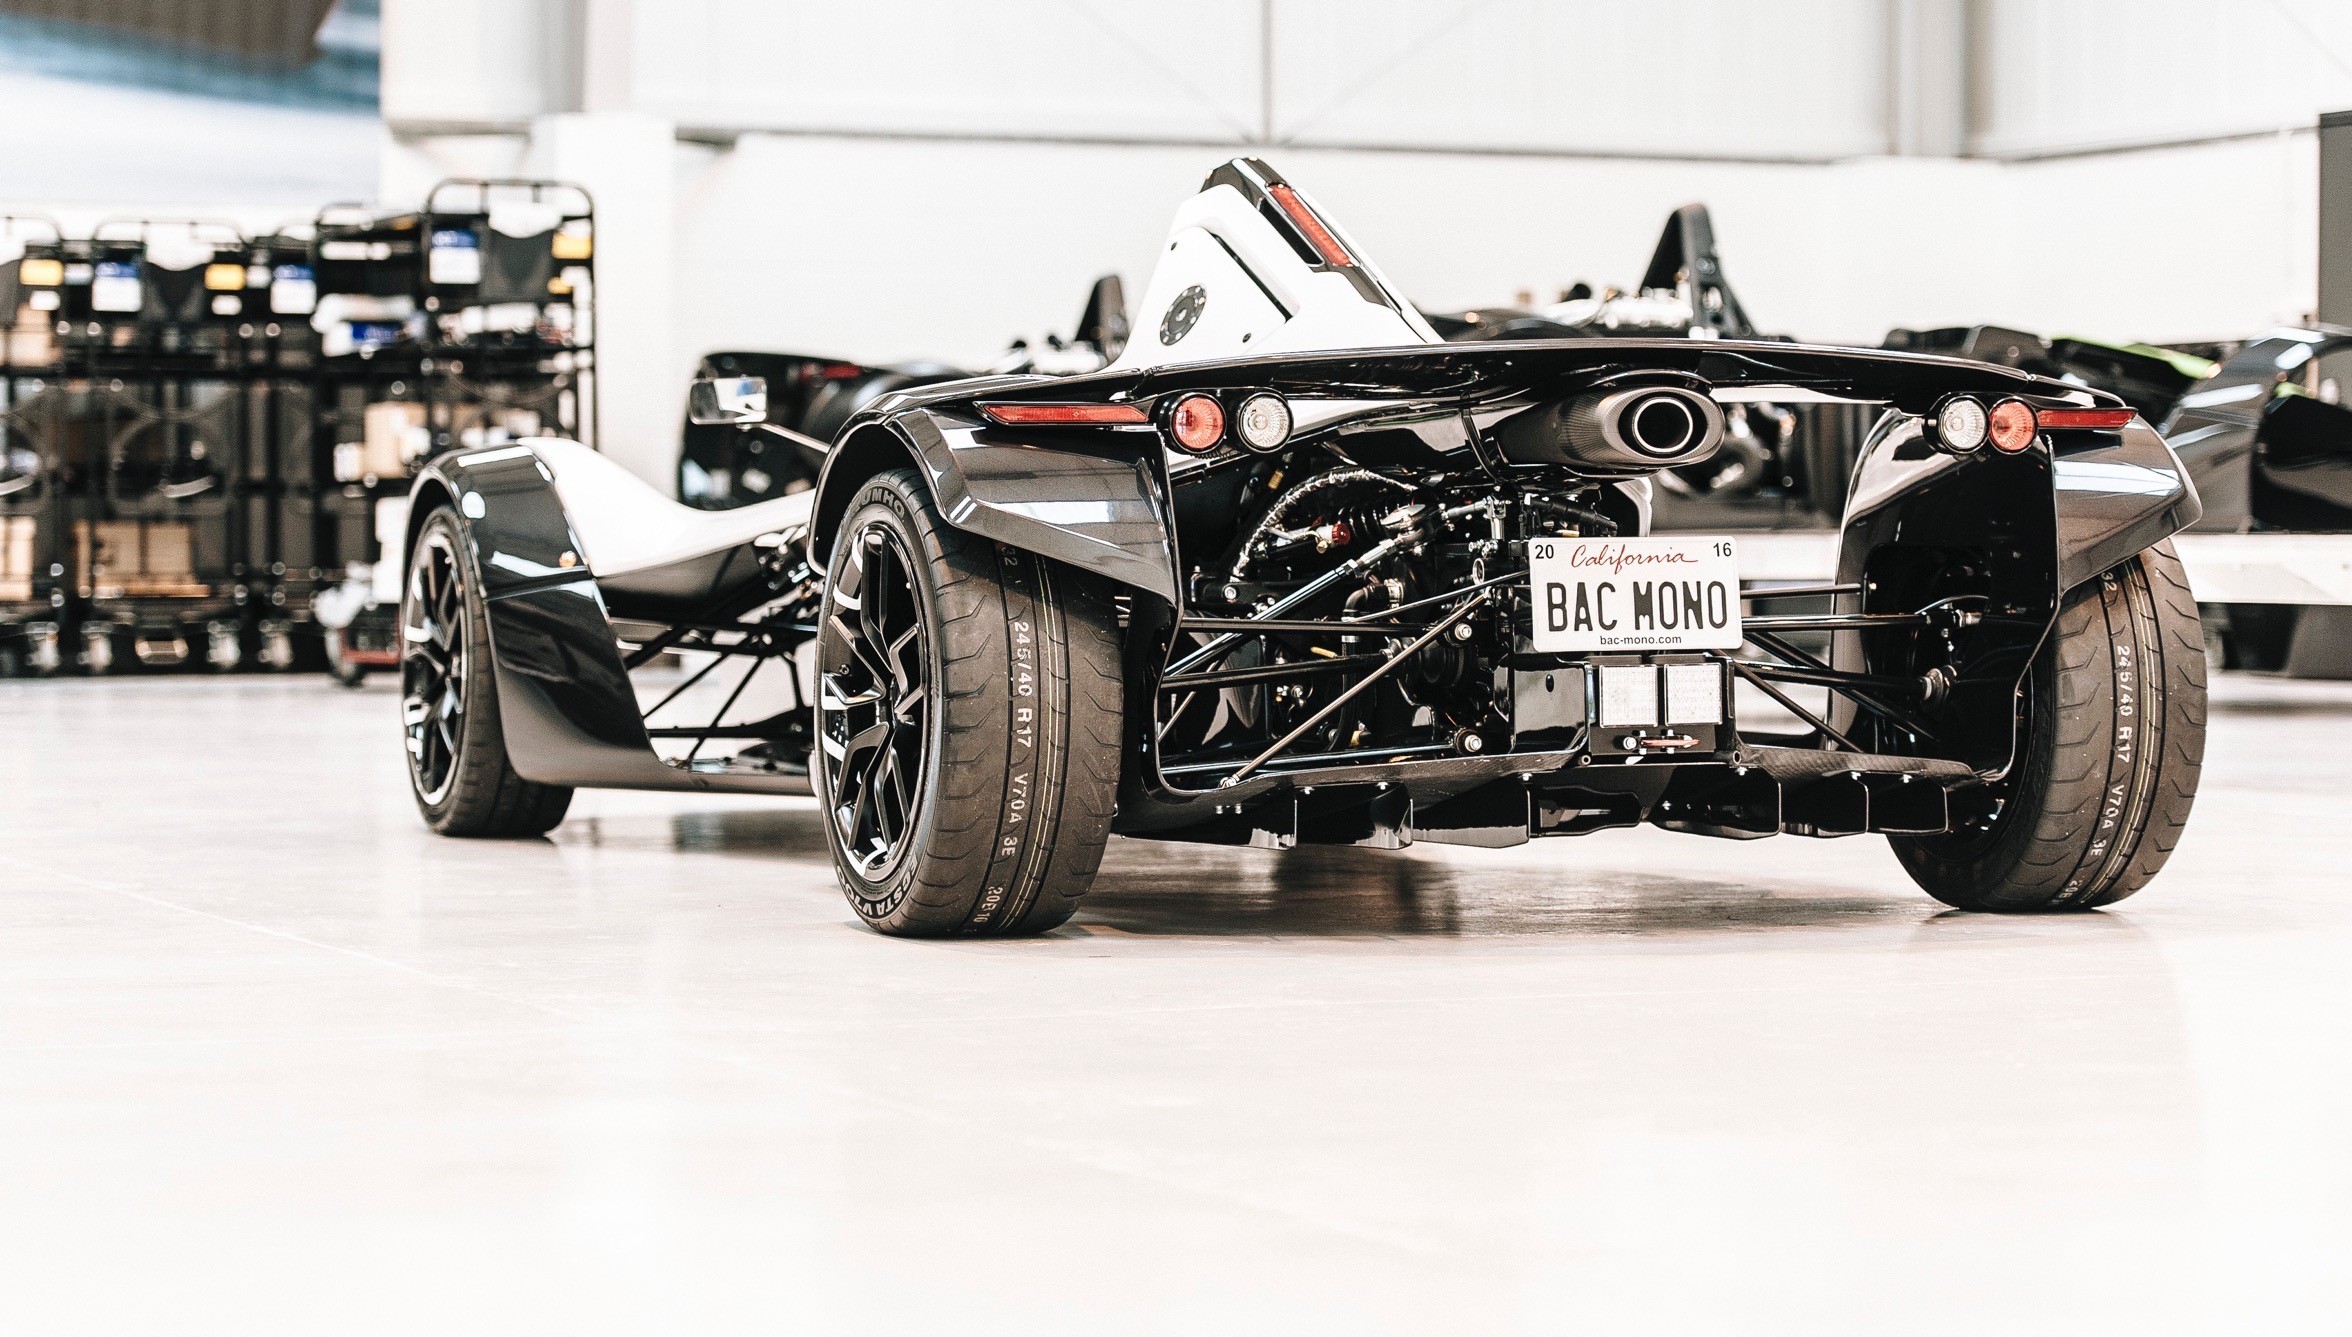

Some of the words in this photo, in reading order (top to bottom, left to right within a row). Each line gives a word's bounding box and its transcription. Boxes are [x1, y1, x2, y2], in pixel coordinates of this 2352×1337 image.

[1534, 544, 1555, 560] 20
[1570, 543, 1699, 575] California
[1712, 542, 1733, 558] 16
[2101, 571, 2118, 592] 32
[1546, 581, 1618, 632] BAC
[1632, 580, 1728, 631] MONO
[1014, 620, 1033, 698] 245/40
[1599, 635, 1682, 645] bac-mono.com
[2116, 644, 2134, 717] 245/40
[1016, 707, 1033, 749] R17
[2117, 726, 2133, 763] R17
[1008, 772, 1029, 824] V70A
[2101, 784, 2125, 829] V70A
